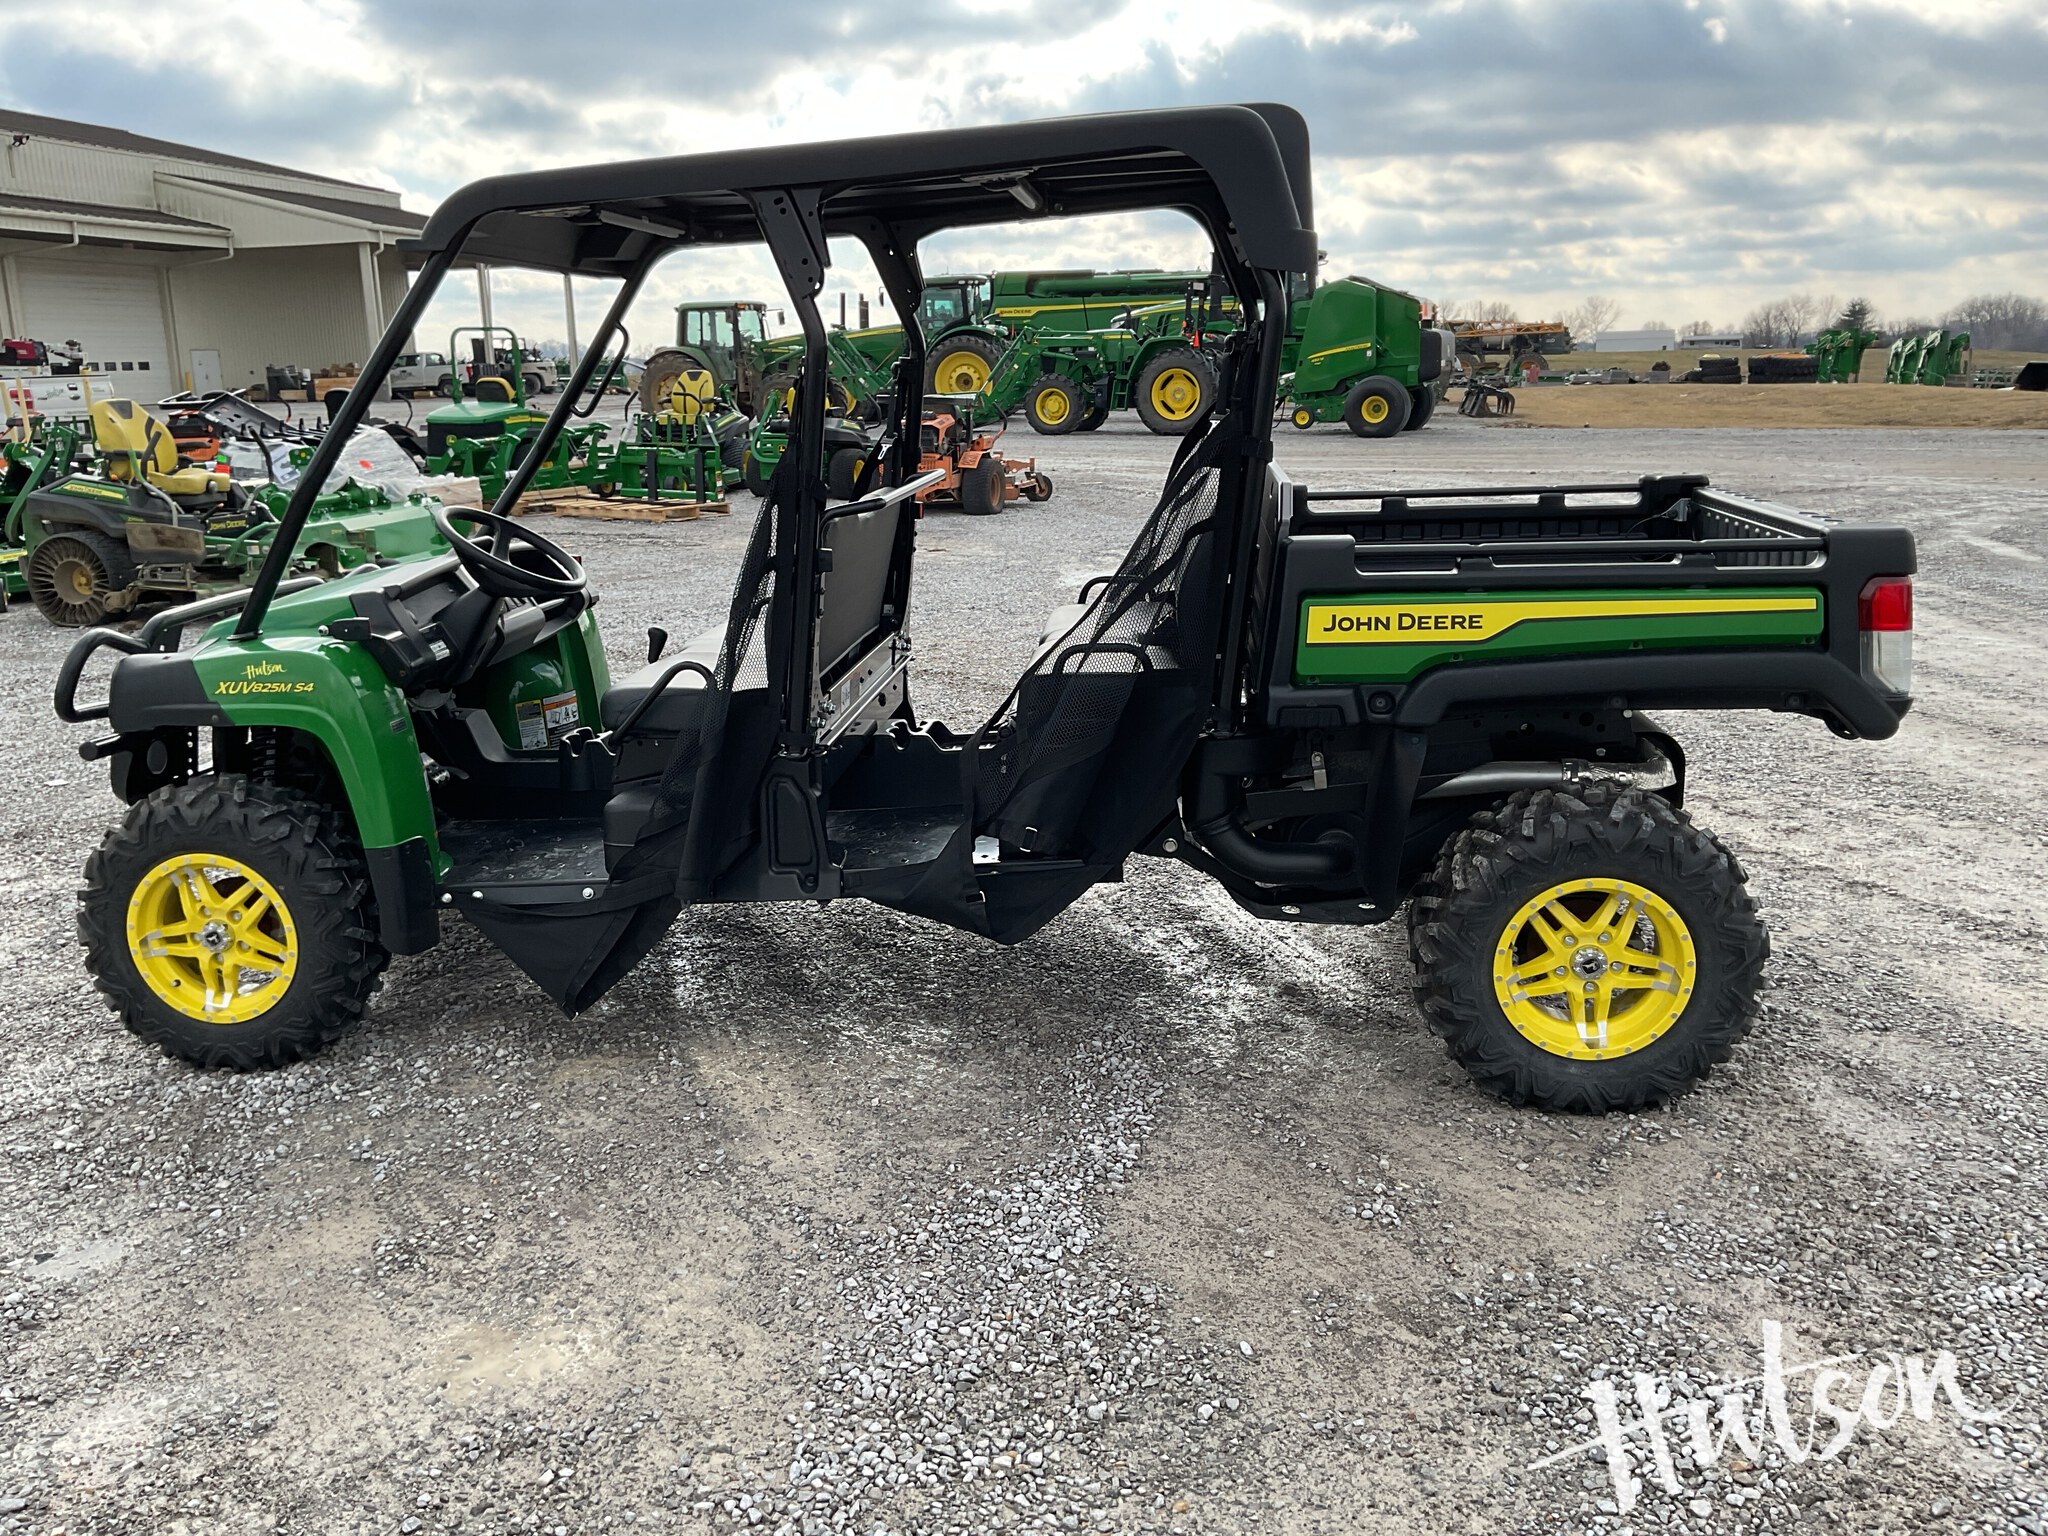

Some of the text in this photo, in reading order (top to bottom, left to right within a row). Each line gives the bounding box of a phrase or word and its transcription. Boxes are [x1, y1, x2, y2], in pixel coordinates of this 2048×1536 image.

[209, 519, 246, 531] JOHN DEERE
[1323, 613, 1483, 631] JOHN DEERE
[240, 660, 287, 680] Hutson
[214, 681, 315, 695] XUV825M S4
